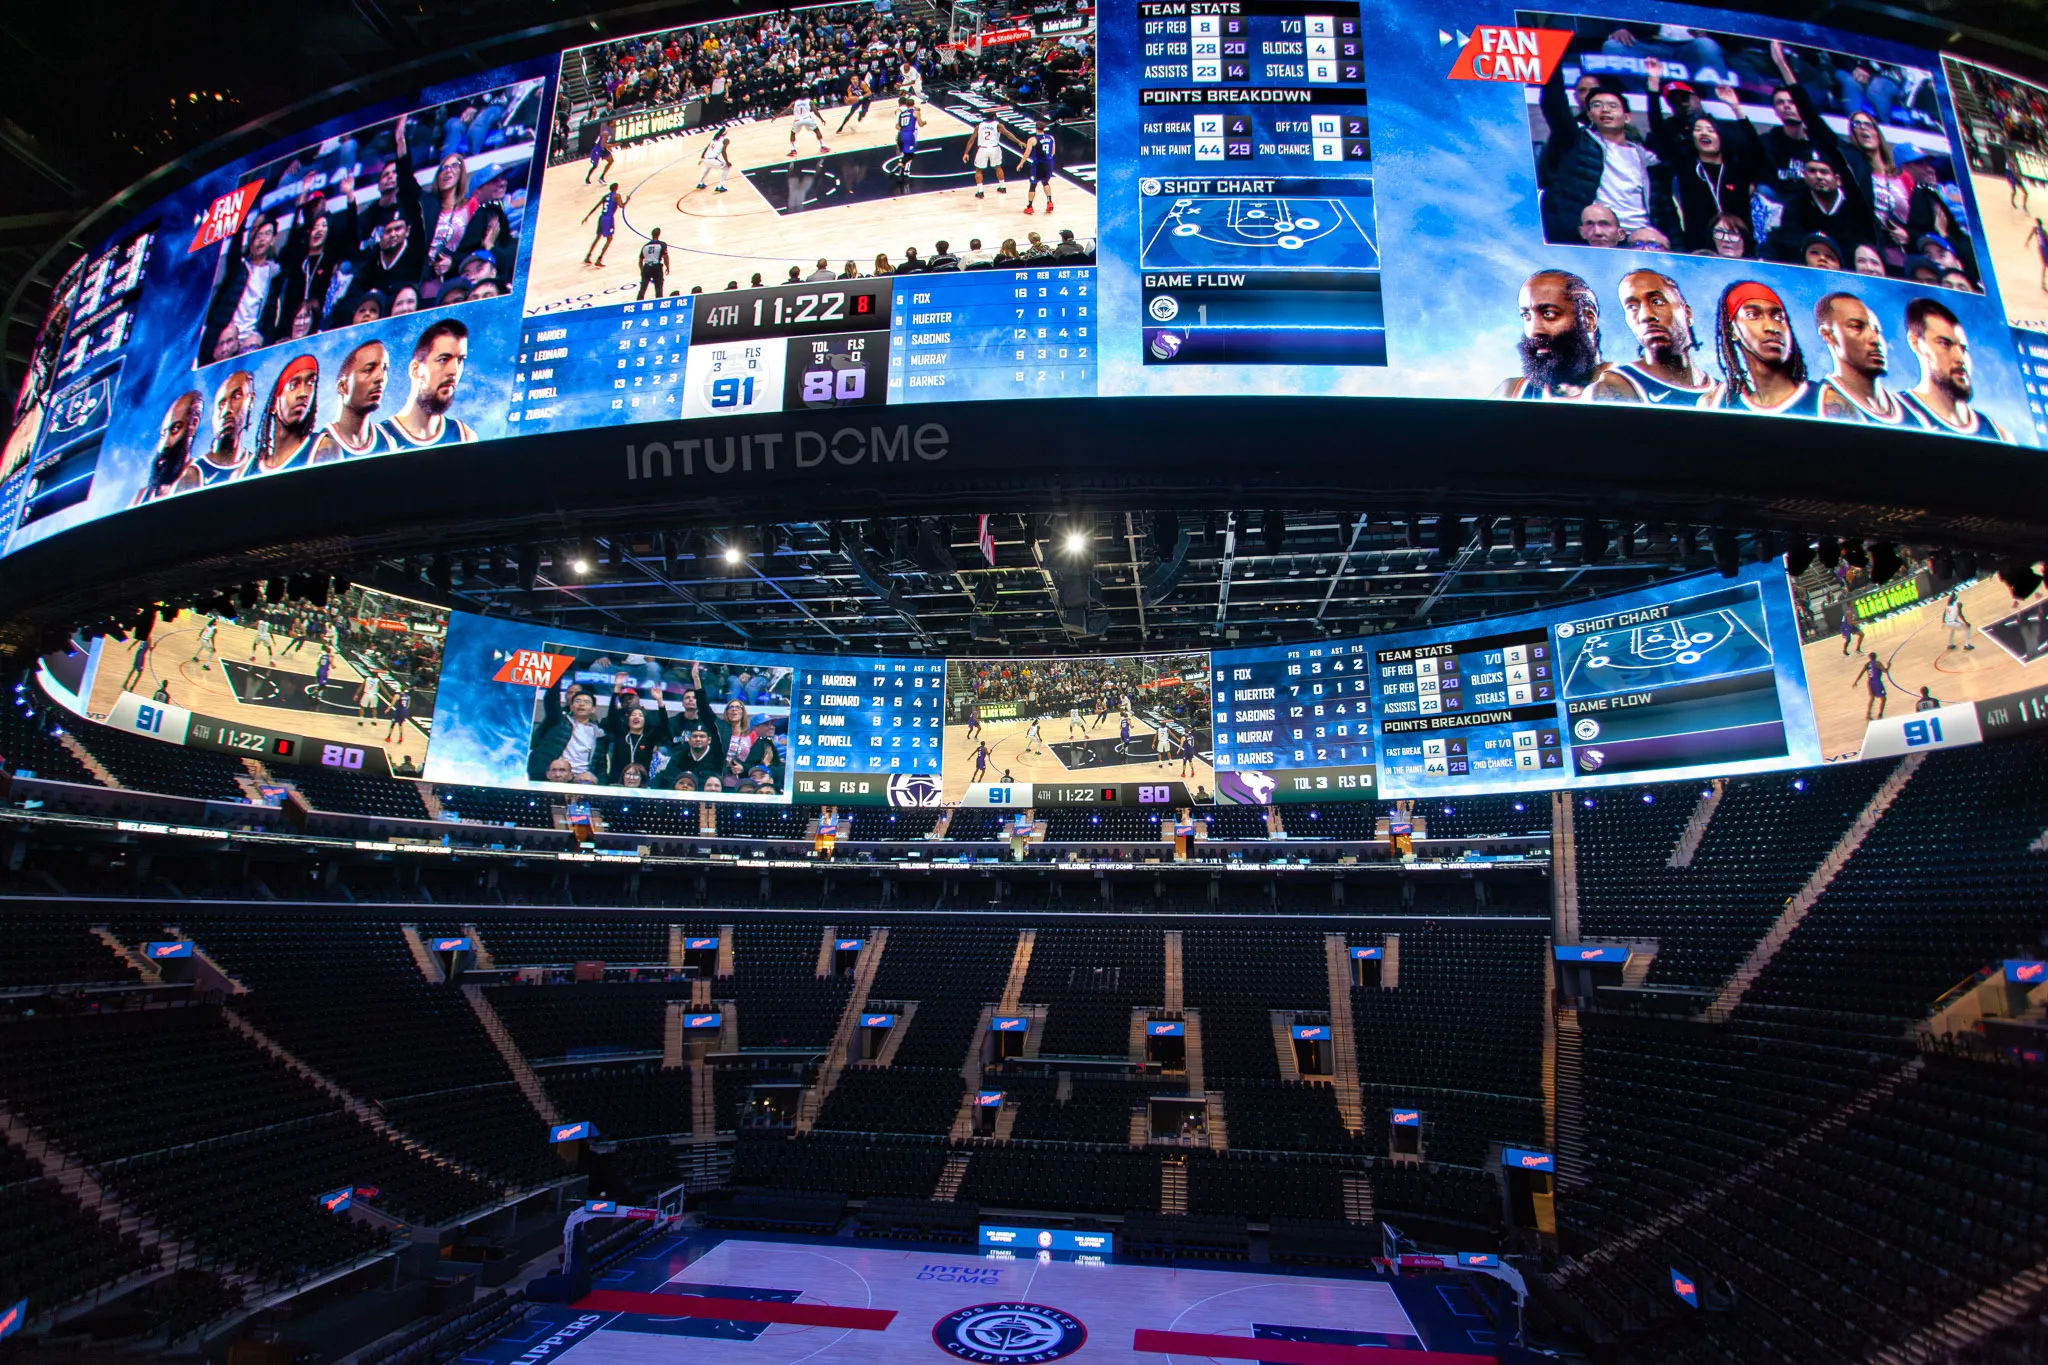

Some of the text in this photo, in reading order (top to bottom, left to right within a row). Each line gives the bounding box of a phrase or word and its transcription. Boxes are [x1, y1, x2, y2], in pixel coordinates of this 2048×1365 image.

[1142, 3, 1240, 14] TEAM STATS
[1145, 21, 1240, 34] OFF REB 8 6
[1281, 20, 1355, 34] T/O 3 8
[1262, 42, 1355, 56] BLOCKS 4 3
[1480, 29, 1538, 56] FAN
[1145, 43, 1246, 56] DEF REB 28 20
[1144, 65, 1245, 78] ASSISTS 23 14
[1266, 65, 1357, 78] STEALS 6 2
[1473, 55, 1542, 82] CAM
[1143, 90, 1311, 102] POINTS BREAKDOWN
[1144, 121, 1244, 133] FAST BREAK 12 4
[1276, 122, 1361, 134] OFF T/O 10 2
[1140, 144, 1250, 155] IN THE PAINT 44 29
[1259, 144, 1363, 156] 2ND CHANCE 8 4
[1165, 181, 1275, 193] SHOT CHART
[214, 190, 245, 221] FAN
[204, 211, 240, 244] CAM
[1016, 270, 1089, 281] PTS REB AST FLS
[1145, 275, 1245, 287] GAME FLOW
[913, 293, 930, 304] FOX
[706, 292, 868, 327] 4TH 11:22 8
[912, 309, 1024, 325] HUERTER 7
[911, 329, 1026, 345] SABONIS 12
[812, 339, 864, 353] TOL FLS
[711, 347, 761, 361] TOL FLS
[815, 352, 860, 364] 3 0
[911, 354, 947, 366] MURRAY
[714, 360, 756, 372] 3 0
[803, 368, 866, 402] 80
[909, 375, 945, 386] BARNES
[711, 377, 755, 408] 91
[1576, 606, 1669, 634] SHOT CHART
[1379, 644, 1453, 662] TEAM STATS
[519, 651, 553, 670] FAN
[510, 667, 551, 685] CAM
[1234, 669, 1251, 680] FOX
[1382, 665, 1413, 677] OFF REB
[822, 674, 856, 687] HARDEN
[1471, 672, 1503, 686] BLOCKS
[1235, 688, 1275, 701] HUERTER
[1383, 683, 1414, 695] DEF REB
[820, 694, 860, 707] LEONARD
[1475, 692, 1505, 705] STEALS
[1569, 693, 1651, 714] GAME FLOW
[1384, 701, 1416, 714] ASSISTS
[819, 715, 845, 727] MANN
[1236, 709, 1275, 722] SABONIS
[1384, 711, 1512, 732] POINTS BREAKDOWN
[136, 704, 164, 733] 91
[216, 727, 266, 752] 11:22
[321, 744, 364, 769] 80
[1236, 730, 1273, 743] MURRAY
[1903, 717, 1943, 747] 91
[818, 735, 852, 747] POWELL
[816, 755, 846, 767] ZUBAC
[1237, 752, 1273, 765] BARNES
[799, 781, 869, 793] TOL 3 FLS 0
[1294, 775, 1372, 790] TOL 3 FLS 0
[989, 786, 1170, 803] 91 4TH 11:22 80
[951, 1304, 1077, 1331] LOS ANGELES
[947, 1342, 1059, 1364] CLIPPERS
